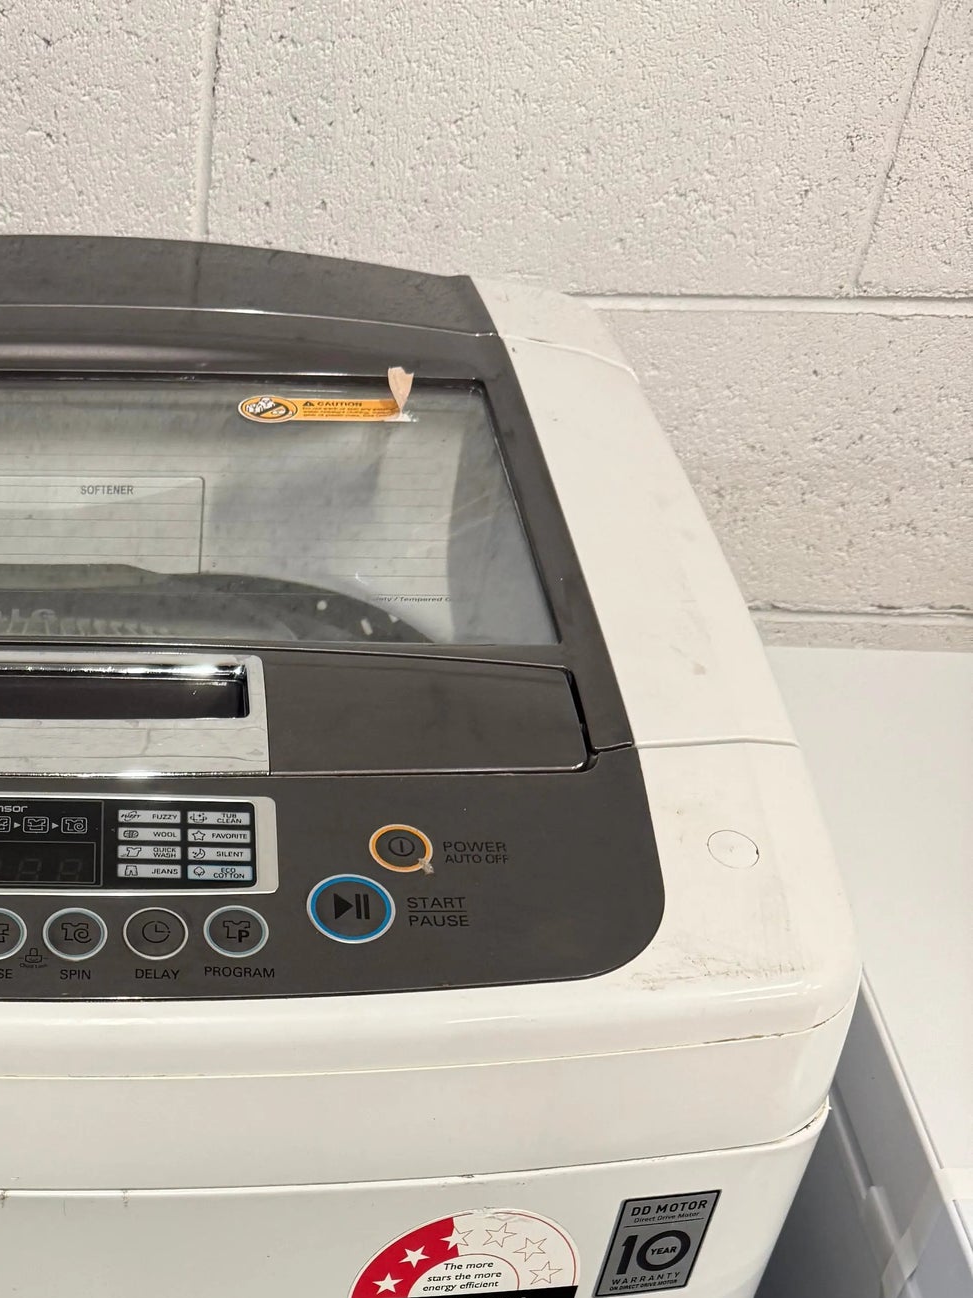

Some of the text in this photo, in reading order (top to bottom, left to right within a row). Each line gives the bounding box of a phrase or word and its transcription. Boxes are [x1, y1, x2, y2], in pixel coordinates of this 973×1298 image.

[80, 485, 134, 495] SOFTENER
[443, 841, 507, 852] POWER
[445, 854, 509, 864] AUTO OFF
[407, 896, 466, 909] START
[409, 915, 470, 927] PAUSE
[59, 969, 91, 980] SPIN
[135, 968, 180, 980] DELAY
[204, 966, 275, 979] PROGRAM
[631, 1200, 708, 1217] DD MOTOR
[616, 1230, 691, 1275] 10
[650, 1246, 678, 1255] YEAR
[443, 1261, 494, 1271] The more
[427, 1271, 502, 1283] stars the more
[612, 1271, 681, 1286] WARRANTY
[423, 1281, 499, 1293] energy efficient
[618, 1283, 639, 1291] DIRECT
